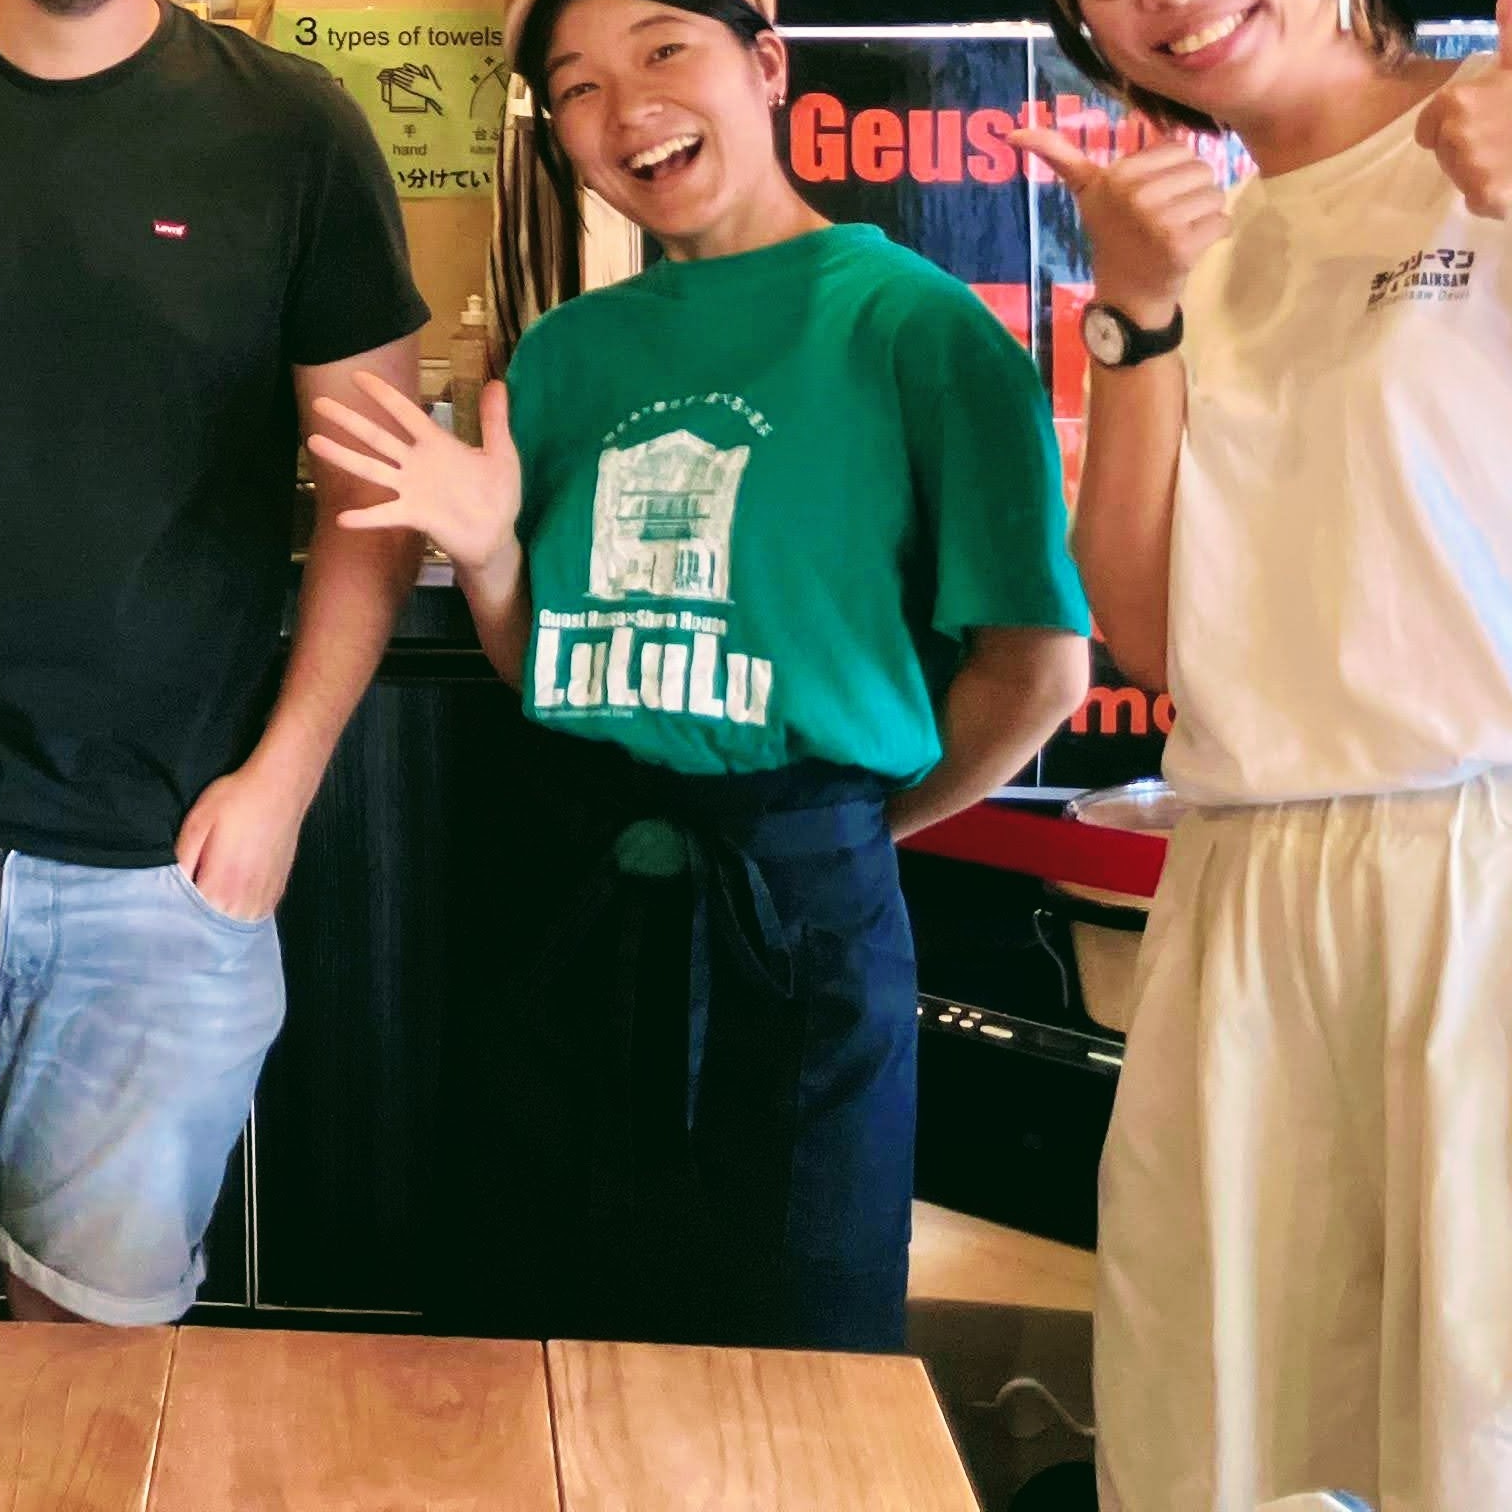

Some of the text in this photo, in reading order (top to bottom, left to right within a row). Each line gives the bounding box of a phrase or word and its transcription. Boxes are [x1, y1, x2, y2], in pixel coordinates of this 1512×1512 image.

[295, 16, 503, 51] 3 types of towels
[392, 143, 428, 156] hand
